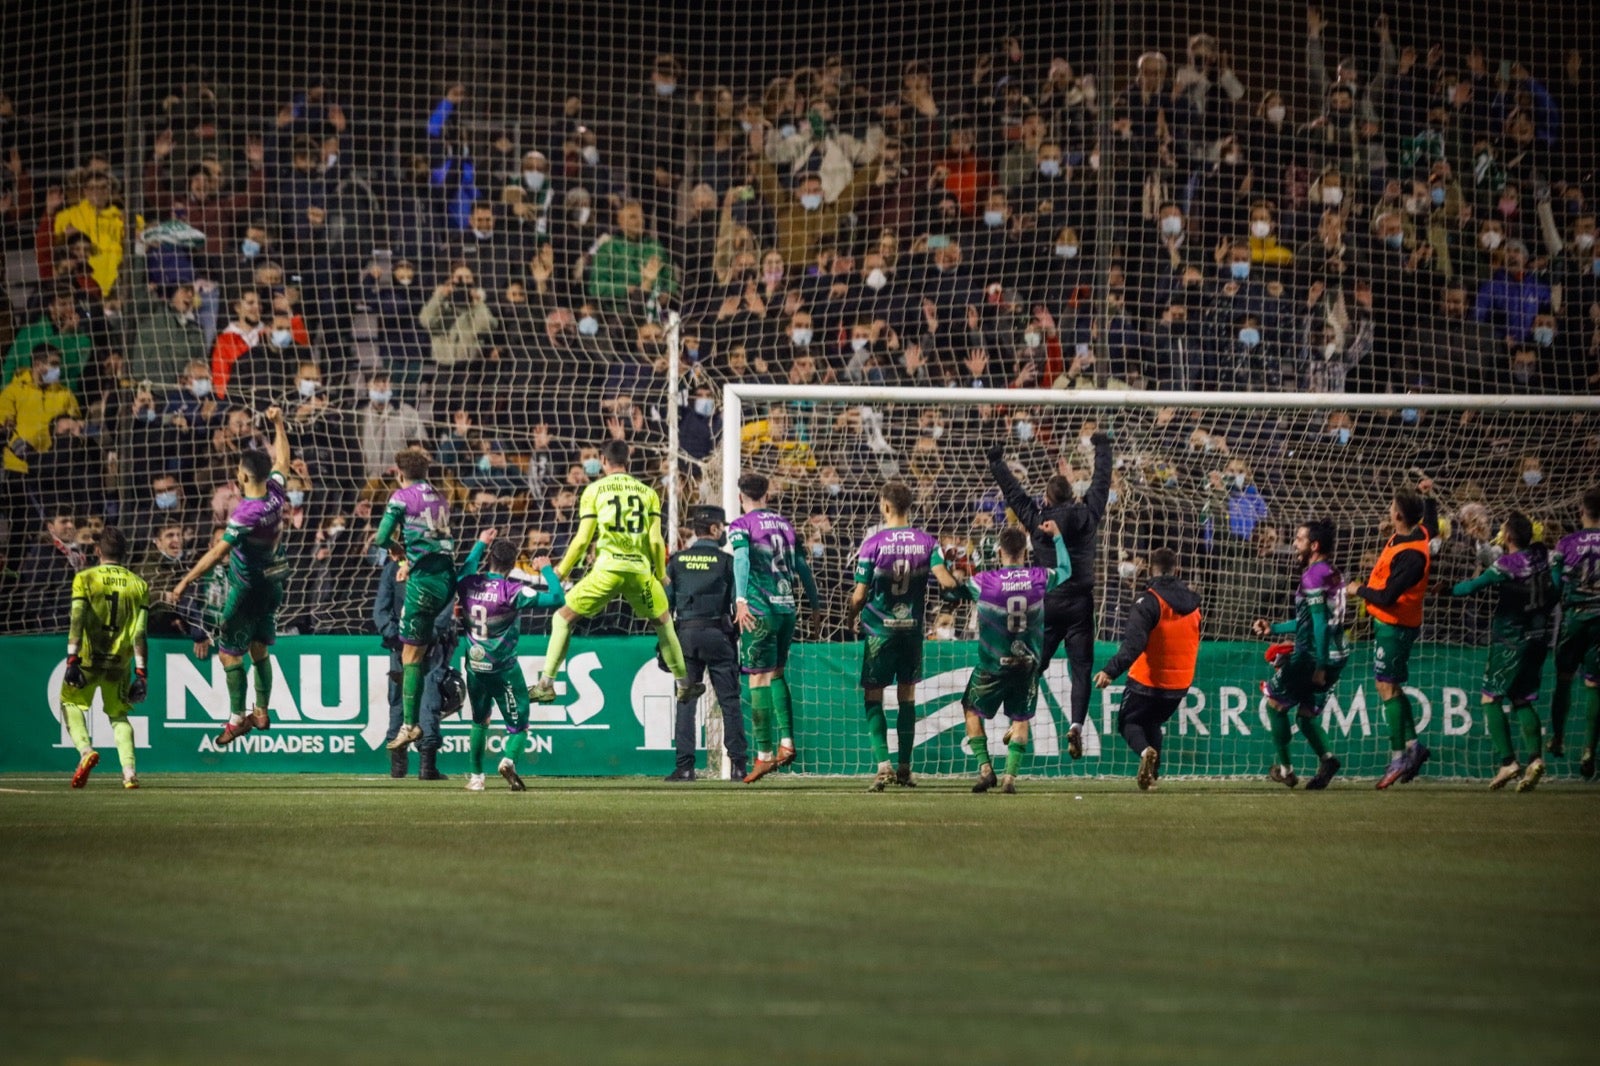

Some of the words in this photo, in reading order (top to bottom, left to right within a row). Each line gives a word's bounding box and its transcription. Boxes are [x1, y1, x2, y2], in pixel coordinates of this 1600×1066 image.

[608, 495, 644, 533] 13
[686, 562, 710, 570] CIVIL
[880, 543, 896, 555] JOSÉ
[103, 577, 127, 587] LOPITO
[891, 560, 911, 595] 9
[102, 591, 119, 632] 1
[471, 604, 488, 640] 3
[1006, 596, 1028, 633] 8
[166, 652, 605, 750] NAUJES
[329, 735, 355, 753] DE
